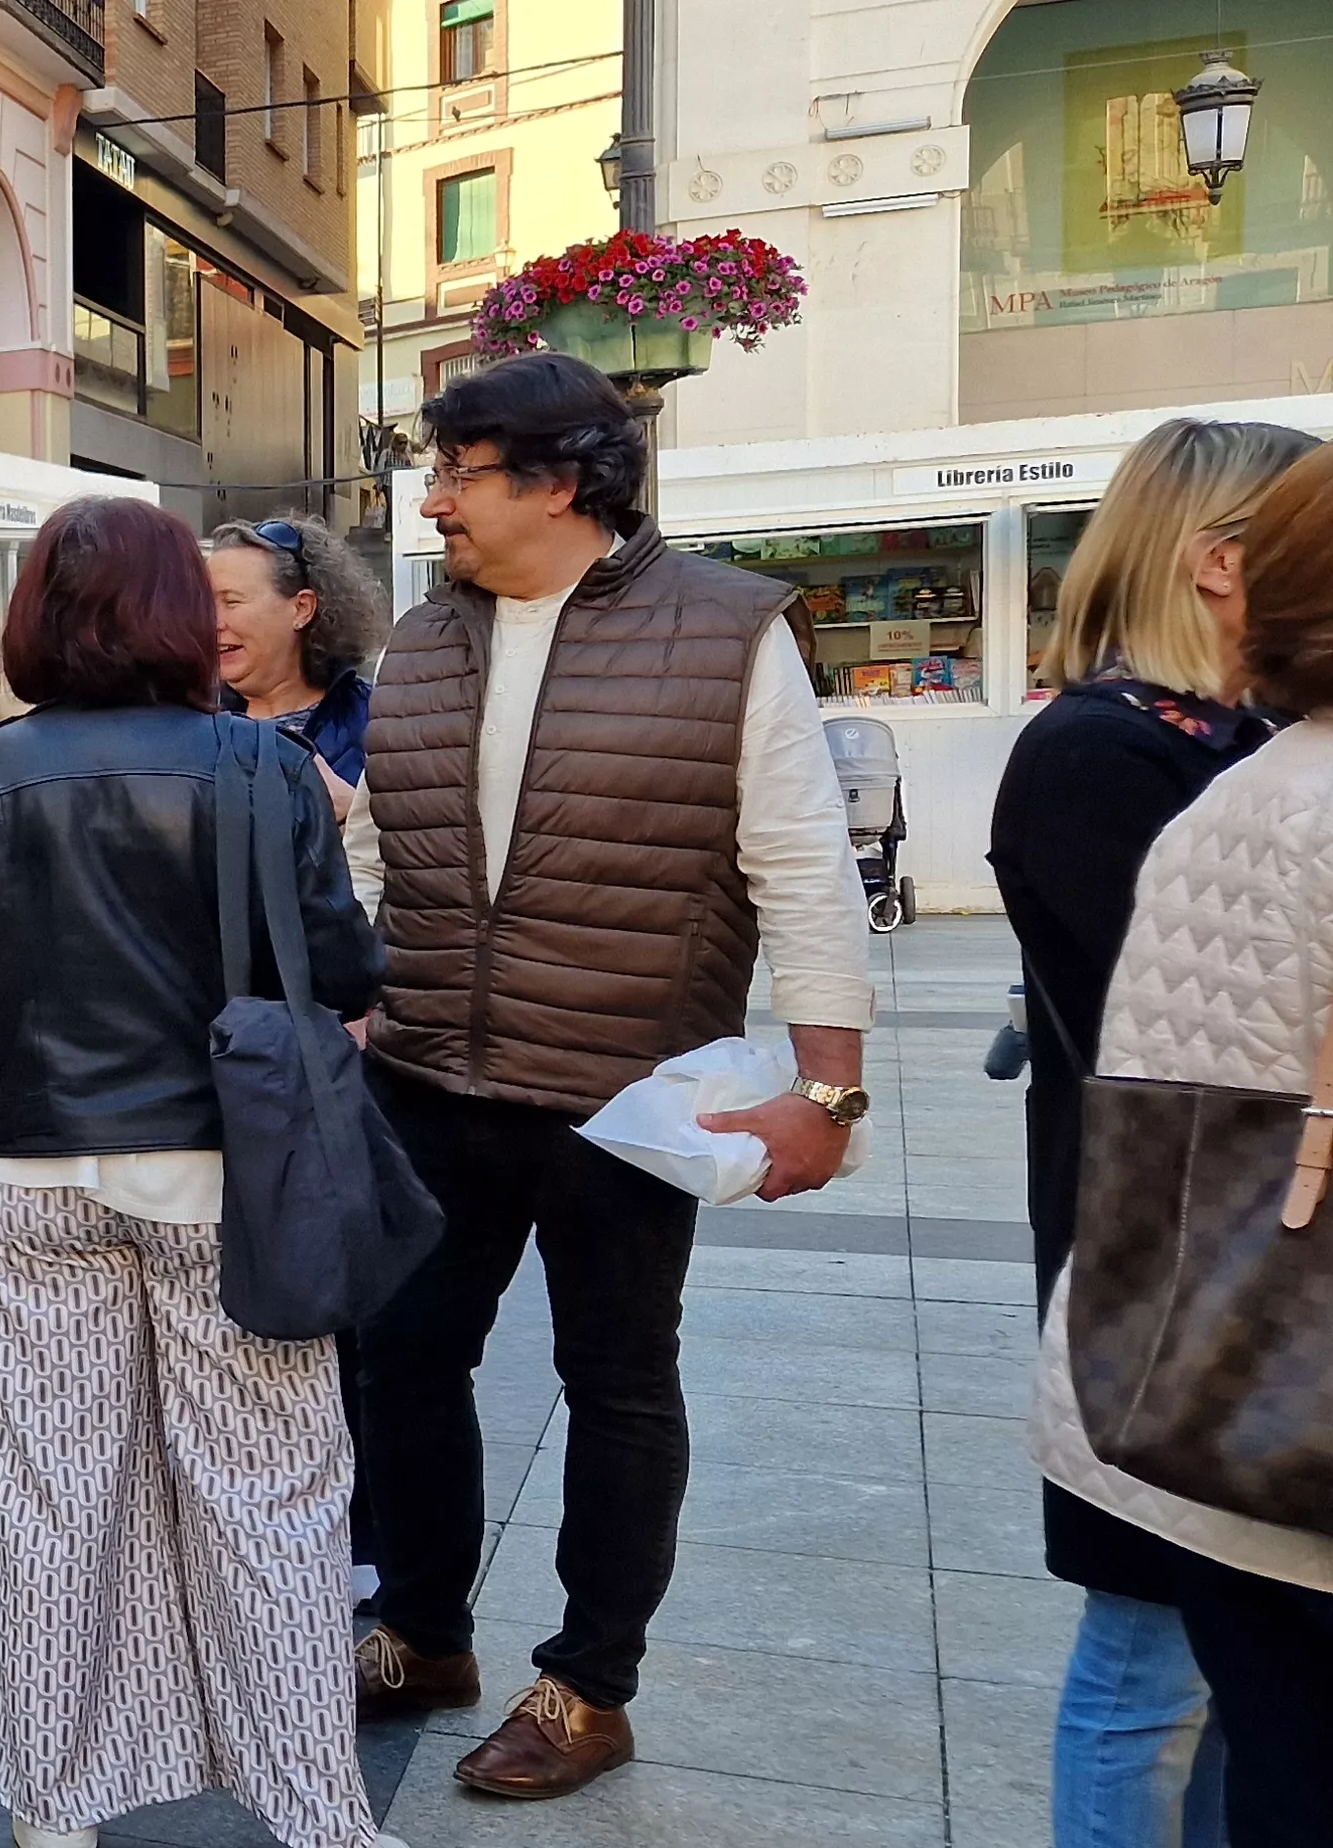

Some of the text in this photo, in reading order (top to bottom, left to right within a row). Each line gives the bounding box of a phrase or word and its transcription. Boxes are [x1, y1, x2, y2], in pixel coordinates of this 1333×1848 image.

[990, 291, 1053, 315] MPA
[1059, 288, 1096, 297] Museo
[1163, 278, 1177, 288] de
[937, 462, 1074, 487] Librería Estilo
[886, 630, 914, 641] 10%
